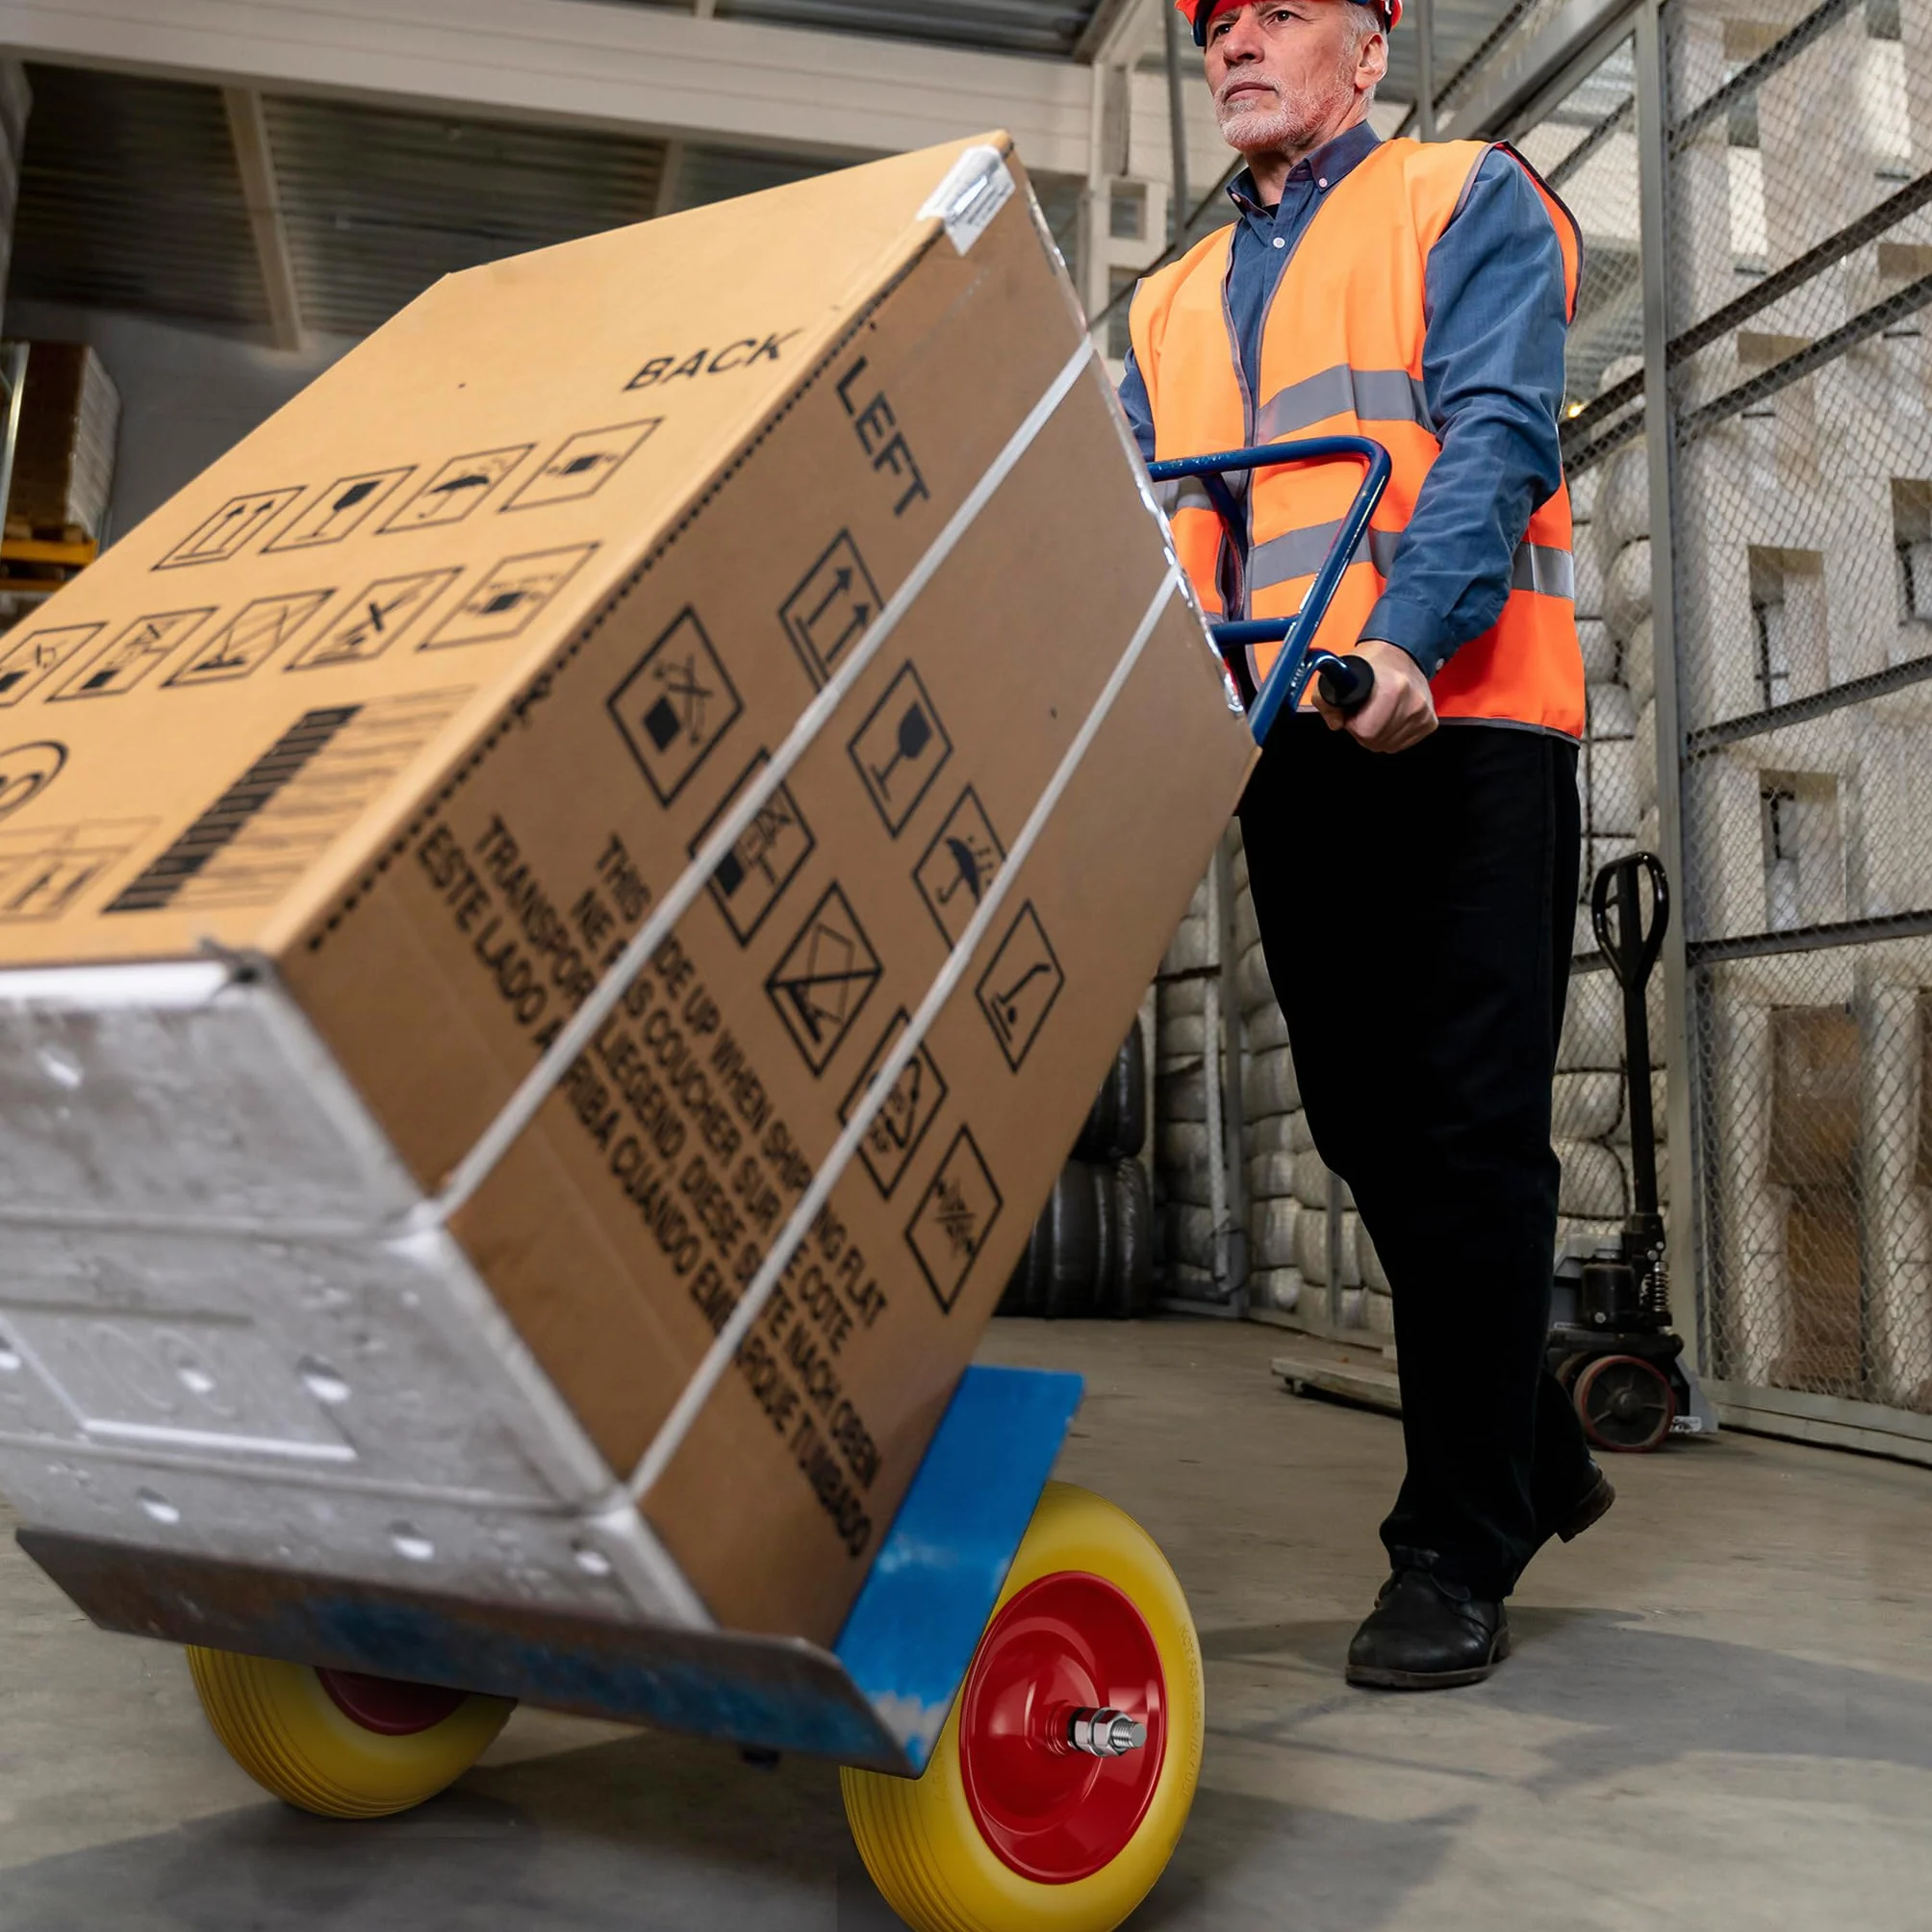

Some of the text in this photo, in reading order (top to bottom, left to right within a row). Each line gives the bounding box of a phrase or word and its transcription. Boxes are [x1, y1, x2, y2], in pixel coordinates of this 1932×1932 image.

[623, 328, 802, 392] BACK
[835, 356, 930, 517] LEFT
[417, 823, 493, 933] ESTE
[473, 918, 547, 1027] LADO
[610, 1136, 700, 1276] CUANDO
[571, 889, 614, 951] NE
[643, 1008, 741, 1167] COUCHER
[732, 1157, 781, 1234] SUR
[799, 1264, 853, 1355] COTE
[597, 833, 650, 924] THIS
[682, 985, 721, 1035] UP
[710, 1031, 772, 1134] WHEN
[837, 1246, 887, 1328] FLAT
[679, 1156, 746, 1258] DIESE
[784, 1324, 840, 1416] NACH
[829, 1399, 883, 1495] OBEN
